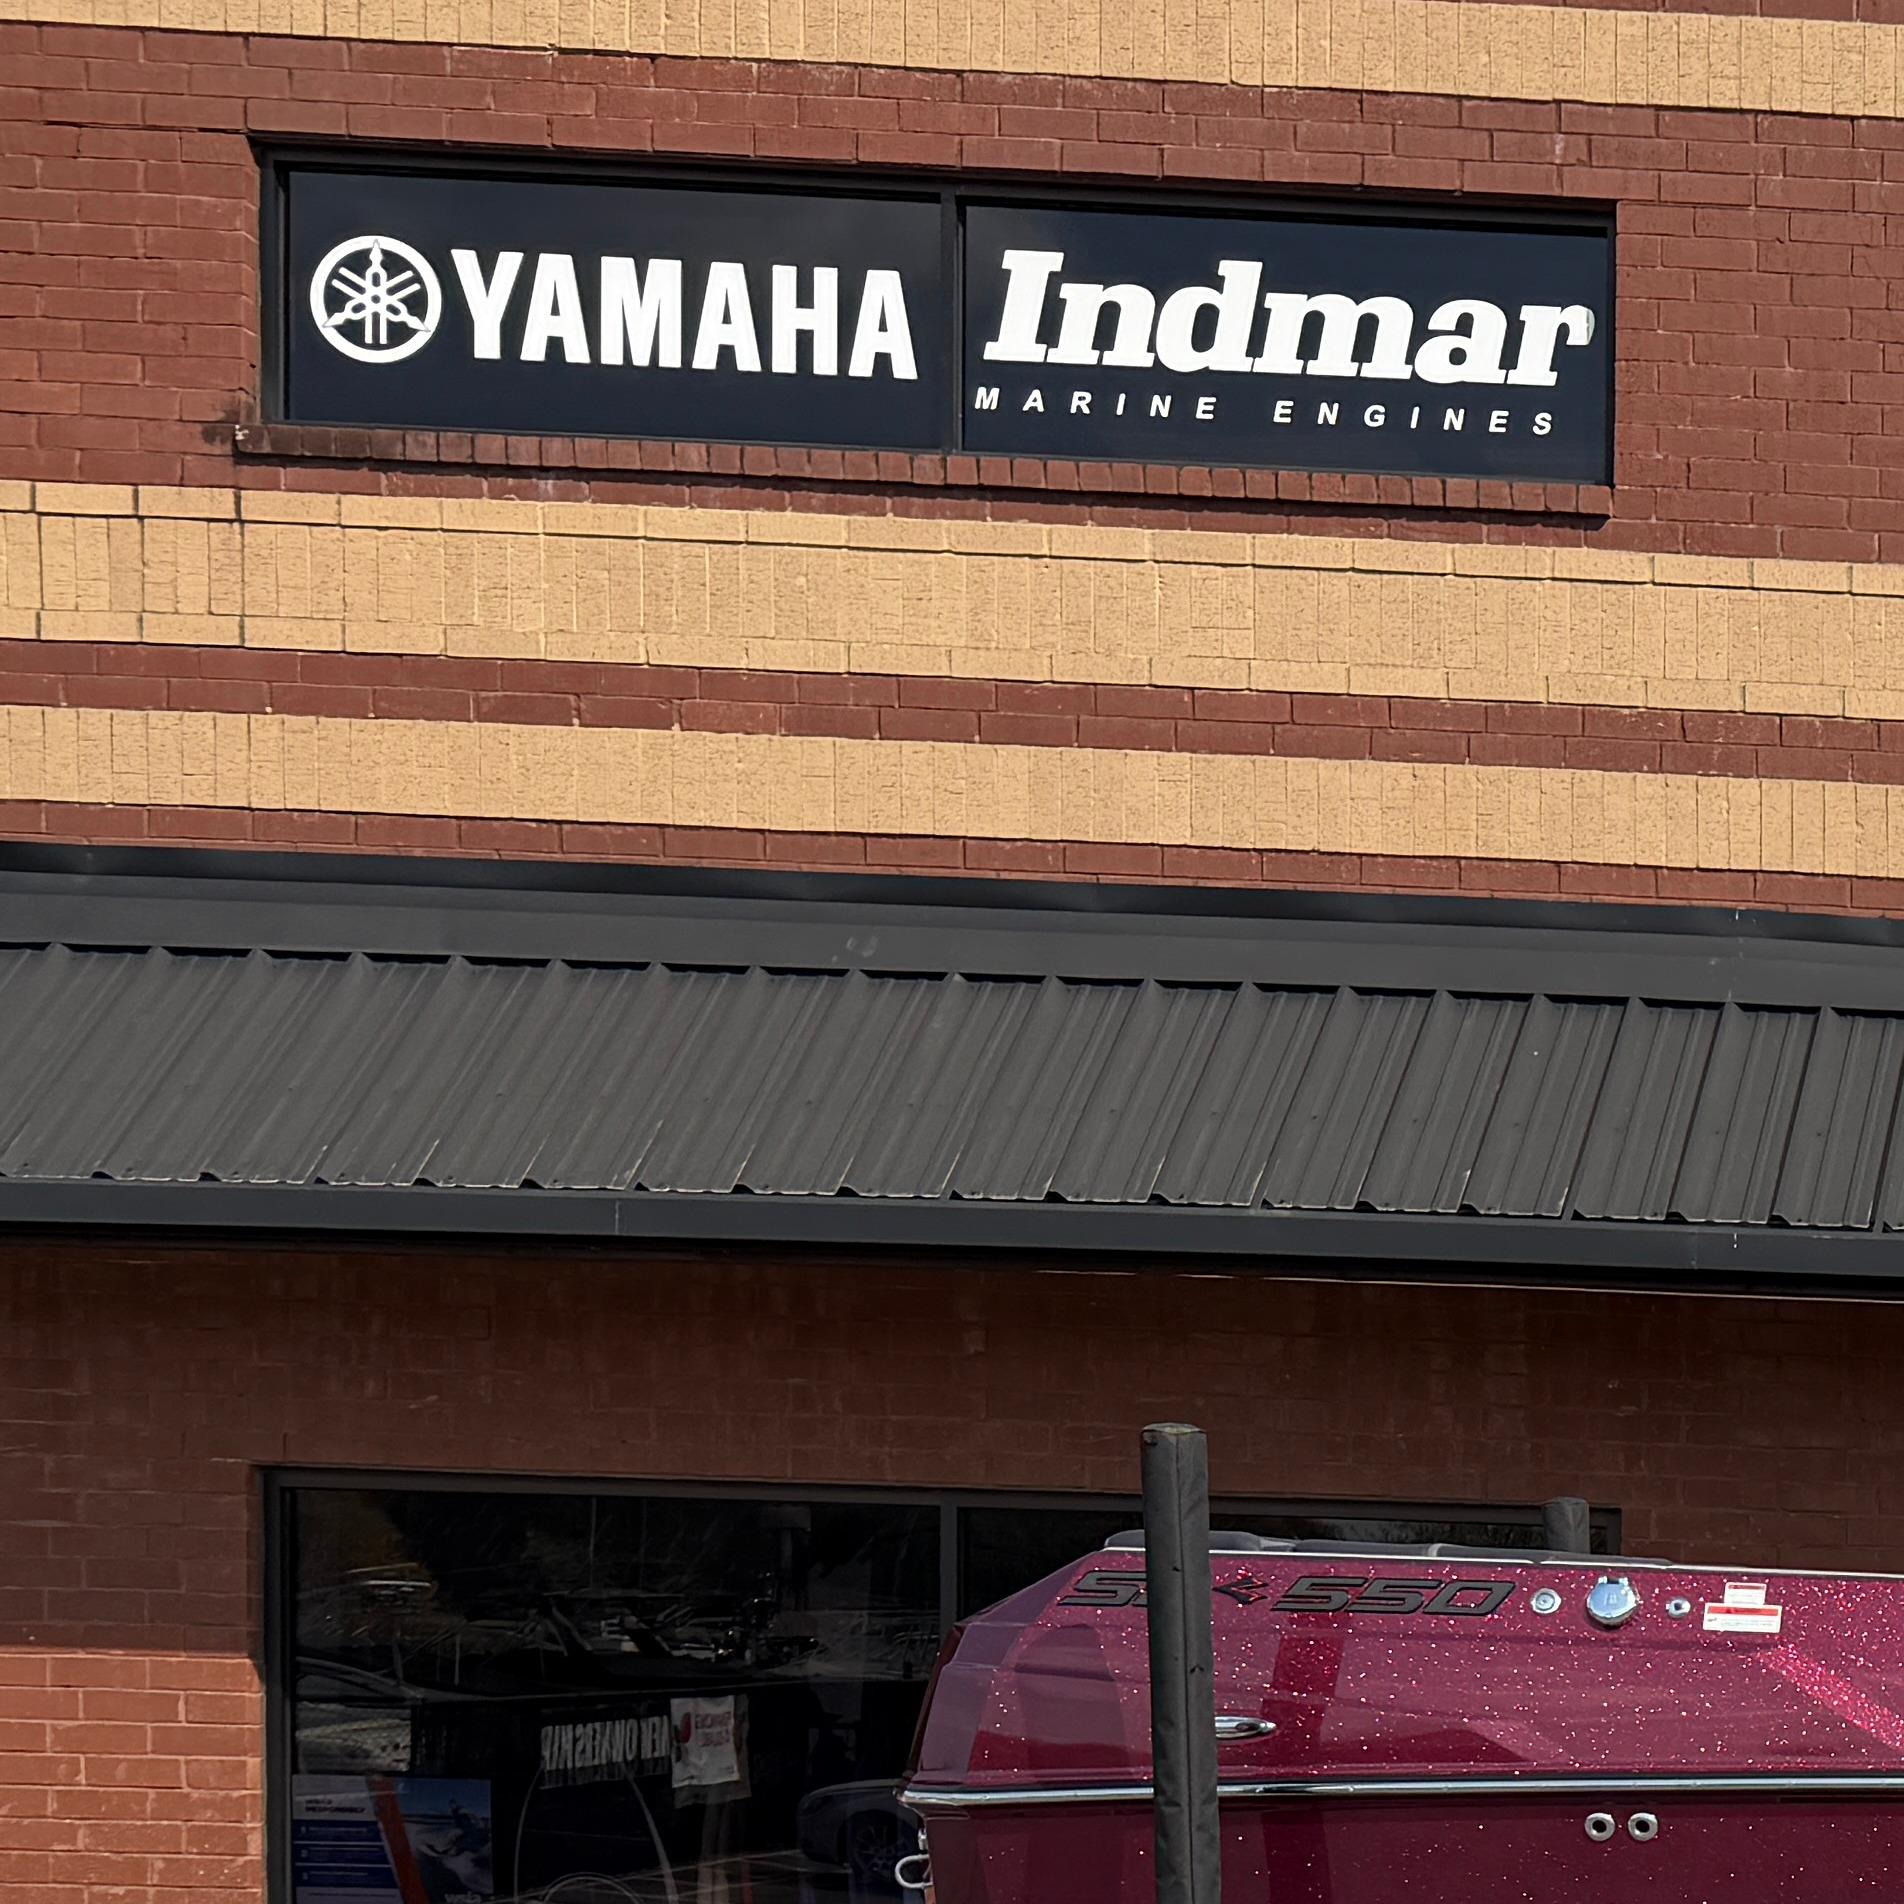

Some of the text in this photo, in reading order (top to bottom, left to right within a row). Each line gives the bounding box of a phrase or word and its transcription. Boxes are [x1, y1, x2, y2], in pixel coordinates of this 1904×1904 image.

[450, 248, 918, 381] YAMAHA
[982, 249, 1596, 387] Indmar
[974, 387, 1555, 437] MARINE ENGINES
[1056, 1570, 1516, 1616] S 550
